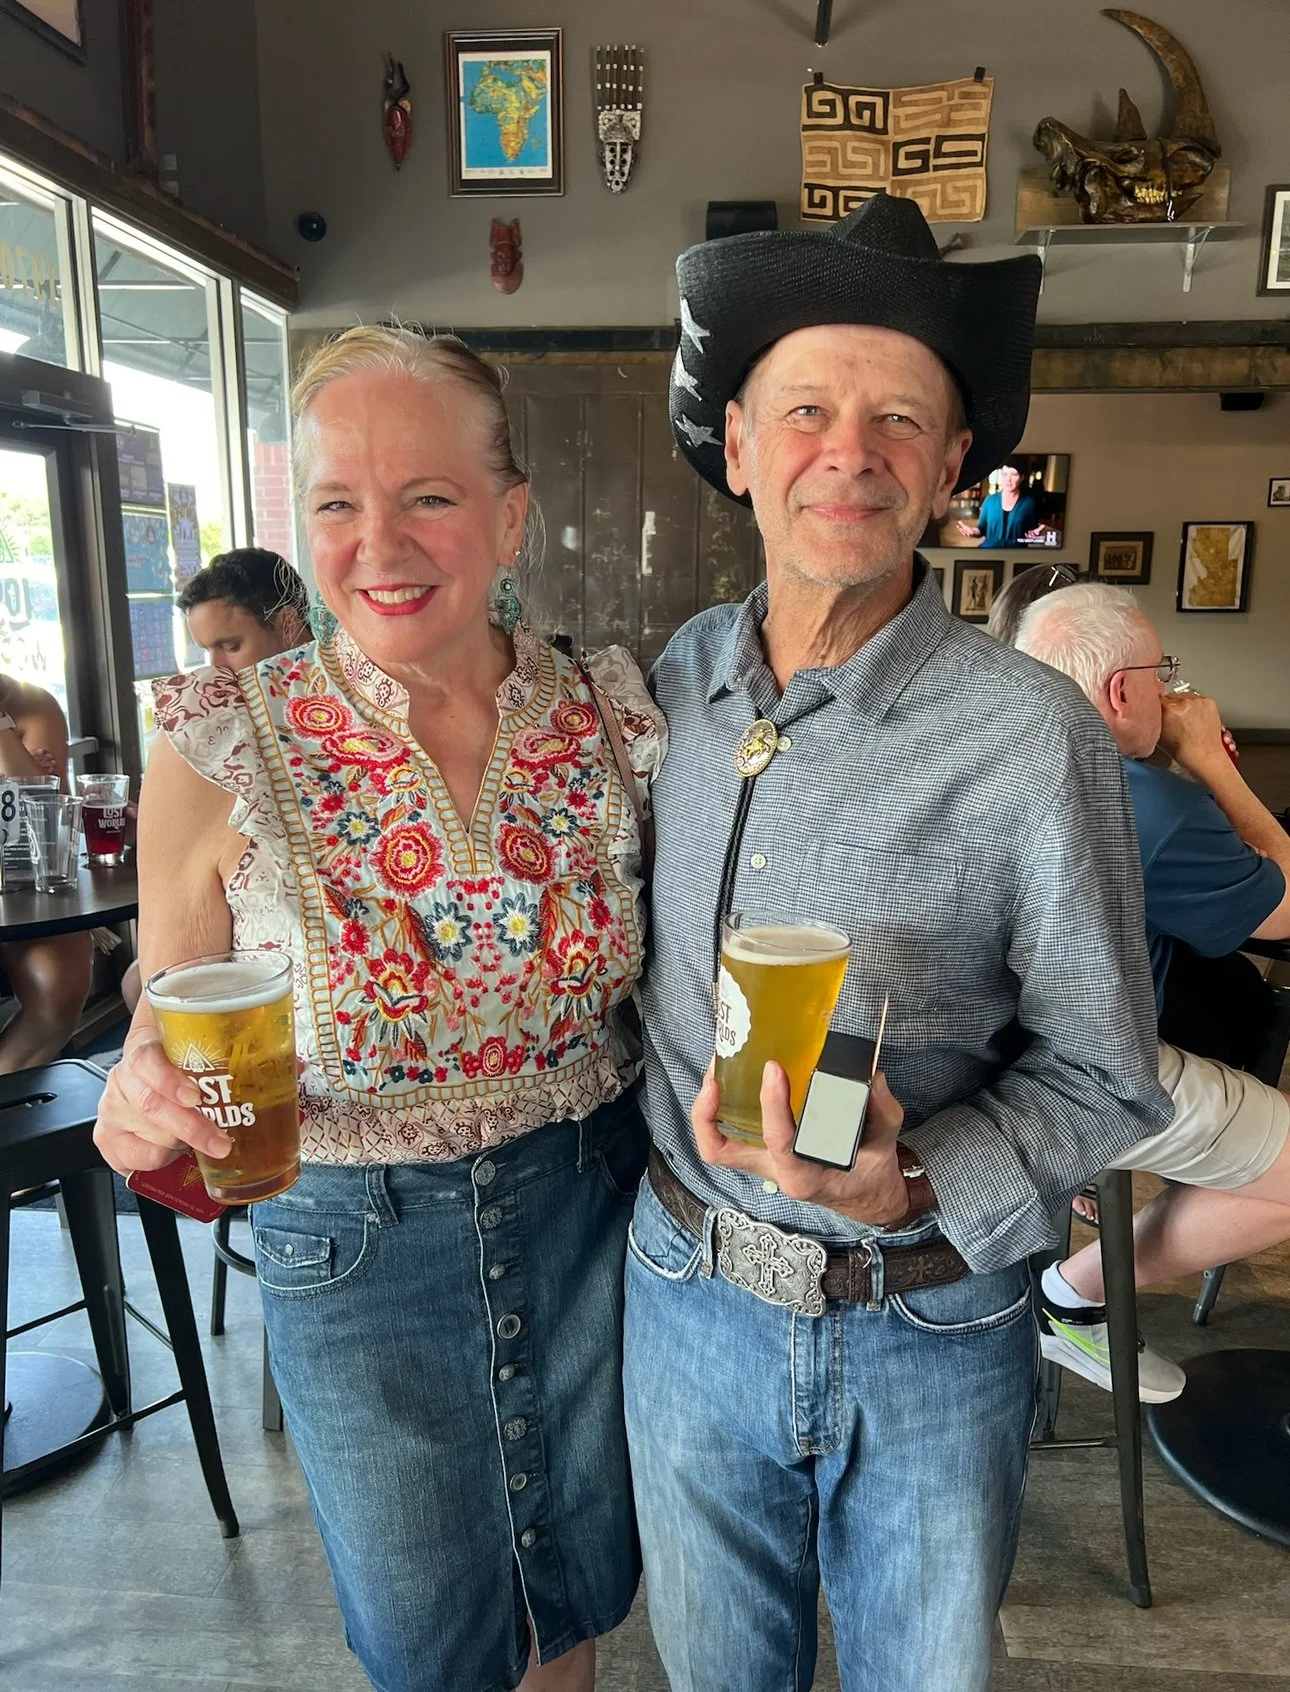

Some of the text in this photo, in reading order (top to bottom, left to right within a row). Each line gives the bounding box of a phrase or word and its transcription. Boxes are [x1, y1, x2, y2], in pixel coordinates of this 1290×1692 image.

[1, 790, 16, 822] 8
[720, 1001, 731, 1024] ST
[188, 1074, 234, 1105] ST
